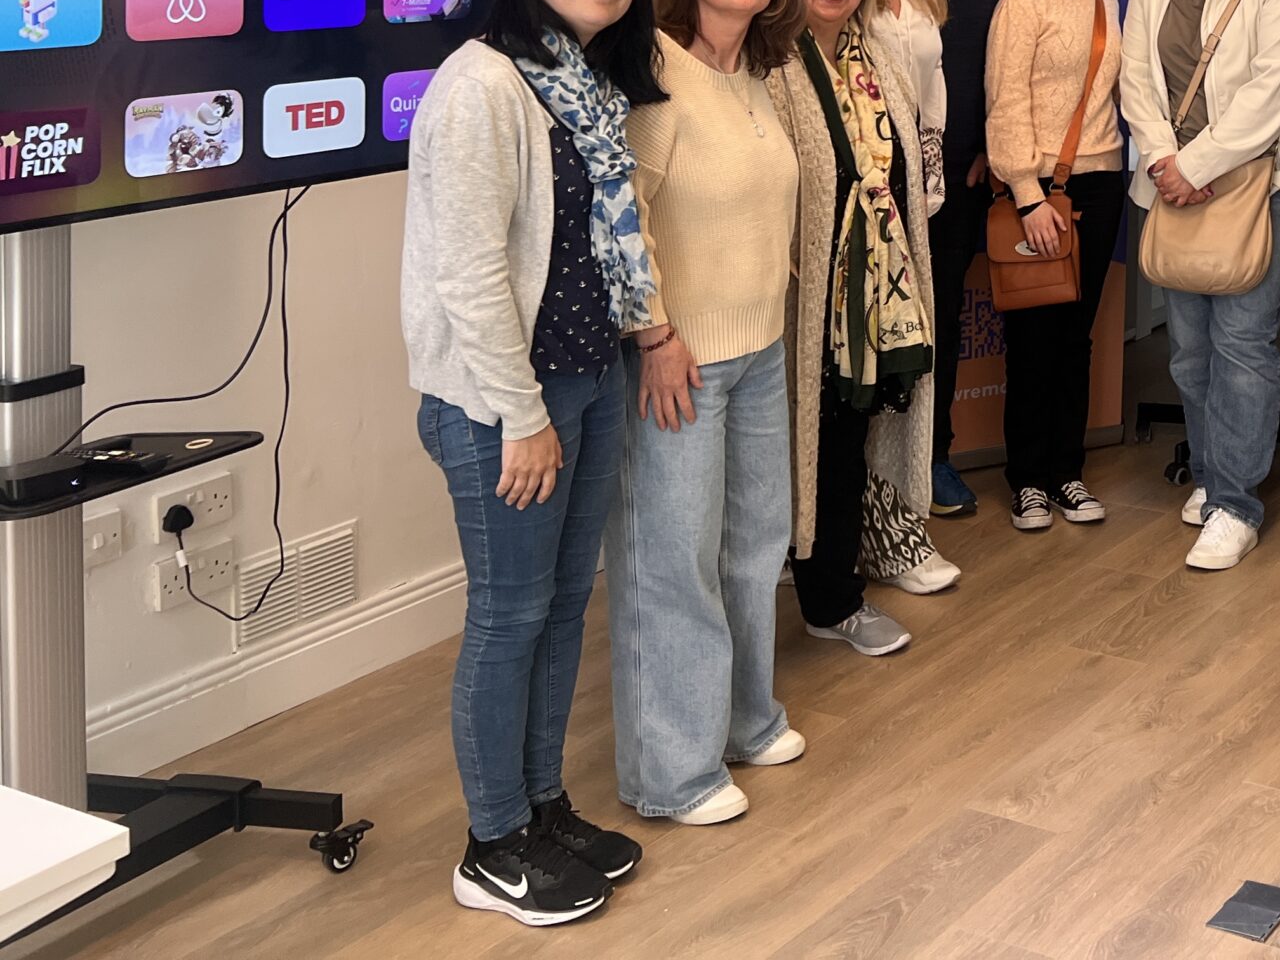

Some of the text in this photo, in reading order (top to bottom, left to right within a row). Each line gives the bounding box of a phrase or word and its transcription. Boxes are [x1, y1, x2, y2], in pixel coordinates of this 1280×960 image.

[286, 100, 345, 132] TED
[25, 123, 69, 142] POP
[21, 137, 84, 159] CORN
[21, 156, 66, 178] FLIX
